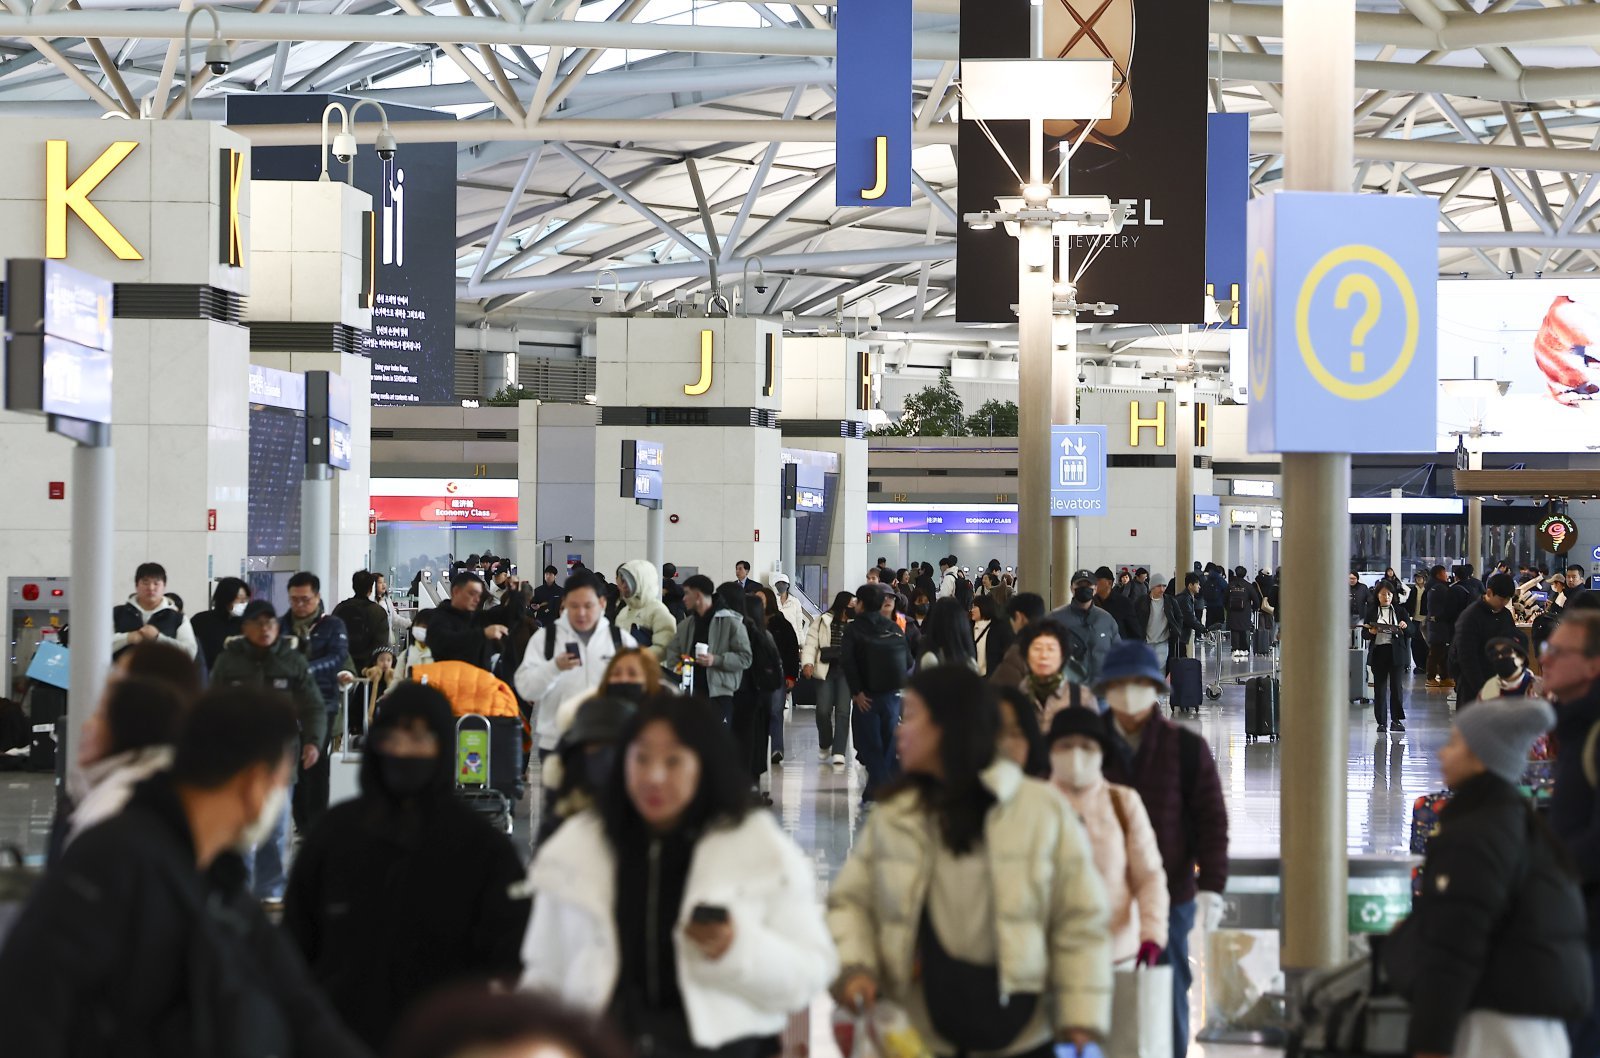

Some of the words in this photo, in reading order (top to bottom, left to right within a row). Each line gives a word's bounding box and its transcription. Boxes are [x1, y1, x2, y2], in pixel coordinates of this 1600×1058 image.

[861, 136, 887, 200] J
[45, 139, 145, 261] K
[228, 148, 245, 268] K
[684, 330, 714, 396] J
[1129, 400, 1166, 447] H
[473, 464, 486, 476] J1
[435, 508, 470, 518] Economy
[470, 508, 490, 517] Class
[894, 493, 907, 502] H2
[996, 494, 1008, 502] H1
